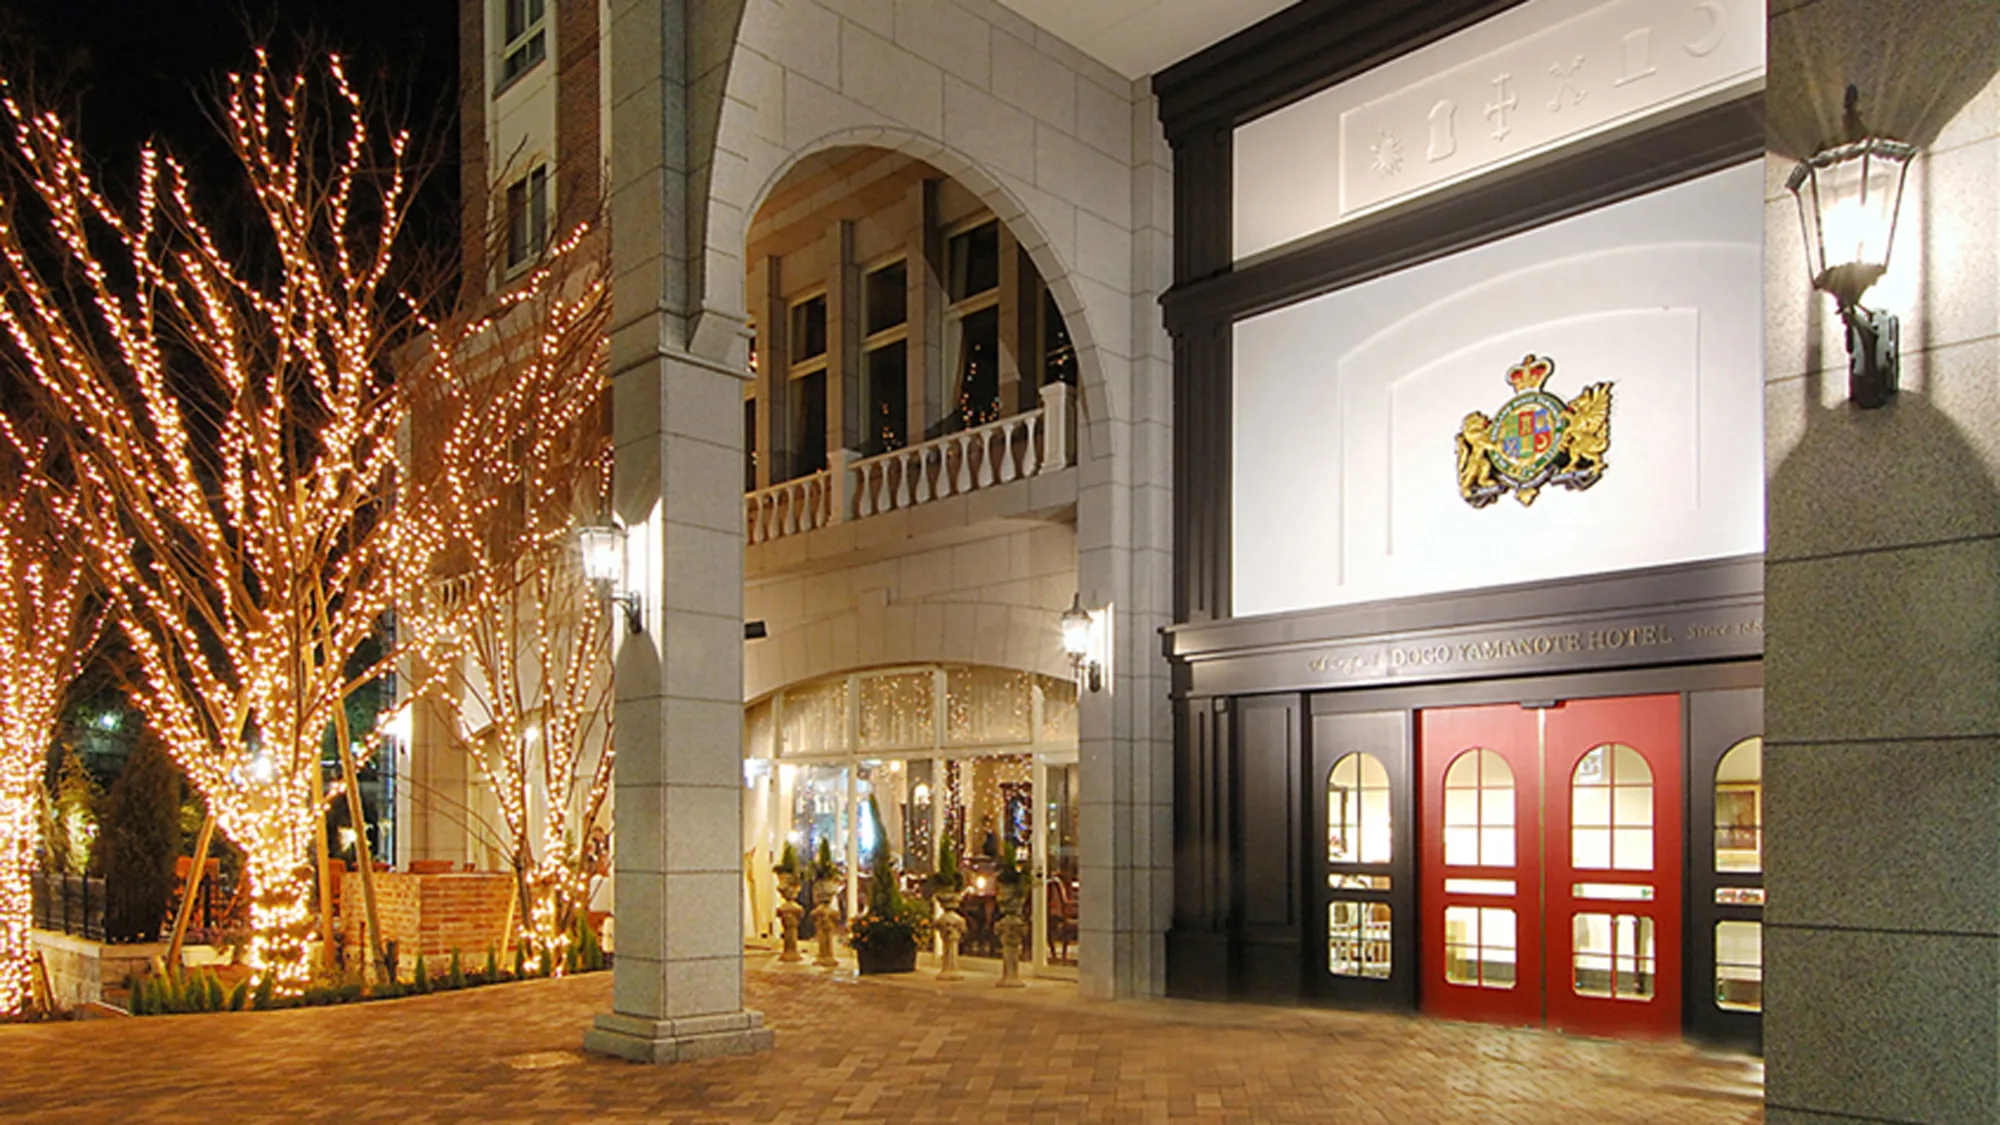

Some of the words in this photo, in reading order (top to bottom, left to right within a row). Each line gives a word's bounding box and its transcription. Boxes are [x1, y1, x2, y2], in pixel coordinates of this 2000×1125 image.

[1391, 643, 1452, 667] DOGO
[1457, 632, 1583, 661] YAMANOTE
[1588, 623, 1674, 650] HOTEL
